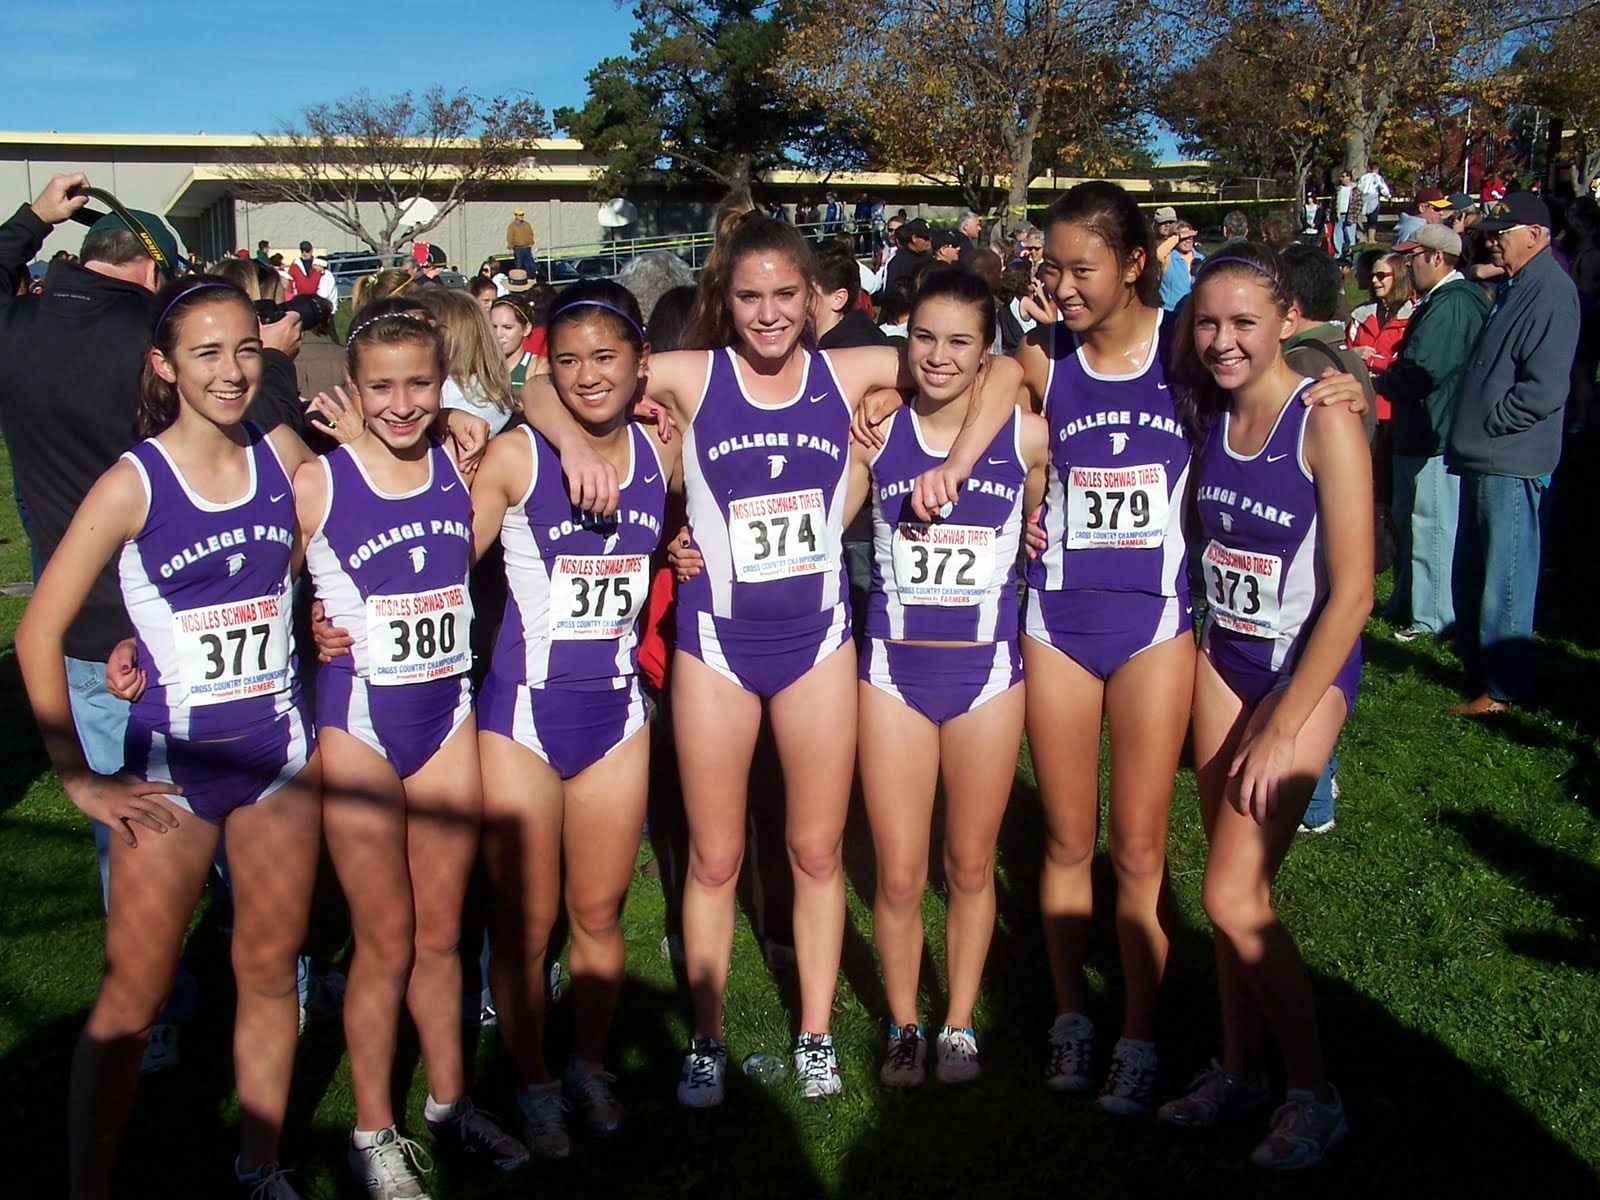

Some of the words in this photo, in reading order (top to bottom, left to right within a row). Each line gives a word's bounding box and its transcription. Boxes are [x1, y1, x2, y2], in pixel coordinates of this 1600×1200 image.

[140, 232, 163, 261] Nikon
[1059, 411, 1131, 442] COLLEGE
[708, 433, 789, 461] COLLEGE
[797, 433, 840, 461] PARK
[880, 479, 915, 501] COLL
[967, 478, 1015, 502] PARK
[1073, 470, 1101, 488] NCS/LES
[1104, 470, 1136, 488] SCHWAB
[1138, 468, 1159, 485] TIRES
[732, 500, 766, 520] NCS/LES
[767, 496, 798, 515] SCHWAB
[799, 492, 821, 510] TIRES
[1084, 489, 1150, 530] 379
[1240, 496, 1295, 528] PARK
[348, 522, 425, 569] COLLEGE
[748, 513, 816, 560] 374
[933, 528, 965, 545] SCHWAB
[968, 530, 988, 546] TIRES
[1075, 531, 1091, 539] CROSS
[1118, 528, 1163, 539] CHAMPIONSHIPS
[160, 528, 247, 578] COLLEGE
[560, 559, 594, 575] NCS/LES
[595, 559, 624, 576] SCHWAB
[624, 557, 641, 573] TIRES
[910, 545, 976, 586] 372
[1253, 556, 1273, 576] TIRES
[742, 564, 760, 573] CROSS
[788, 563, 816, 574] FARMERS
[375, 598, 411, 617] NCS/LES
[413, 593, 444, 615] SCHWAB
[443, 588, 464, 608] TIRES
[571, 577, 632, 618] 375
[899, 586, 915, 594] CROSS
[916, 587, 940, 595] COUNTRY
[942, 588, 985, 596] CHAMPIONSHIPS
[941, 595, 970, 603] FARMERS
[1211, 565, 1260, 615] 373
[181, 610, 220, 633] NCS/LES
[221, 602, 257, 627] SCHWAB
[257, 598, 279, 619] TIRES
[389, 612, 455, 662] 380
[199, 623, 271, 680] 377
[377, 665, 397, 675] CROSS
[400, 663, 426, 673] COUNTRY
[427, 652, 465, 669] CHAMPIONSHIPS
[190, 684, 212, 694] CROSS
[213, 679, 241, 690] COUNTRY
[243, 669, 285, 685] CHAMPIONSHIP
[427, 665, 454, 678] FARMERS
[243, 681, 275, 694] FARMERS
